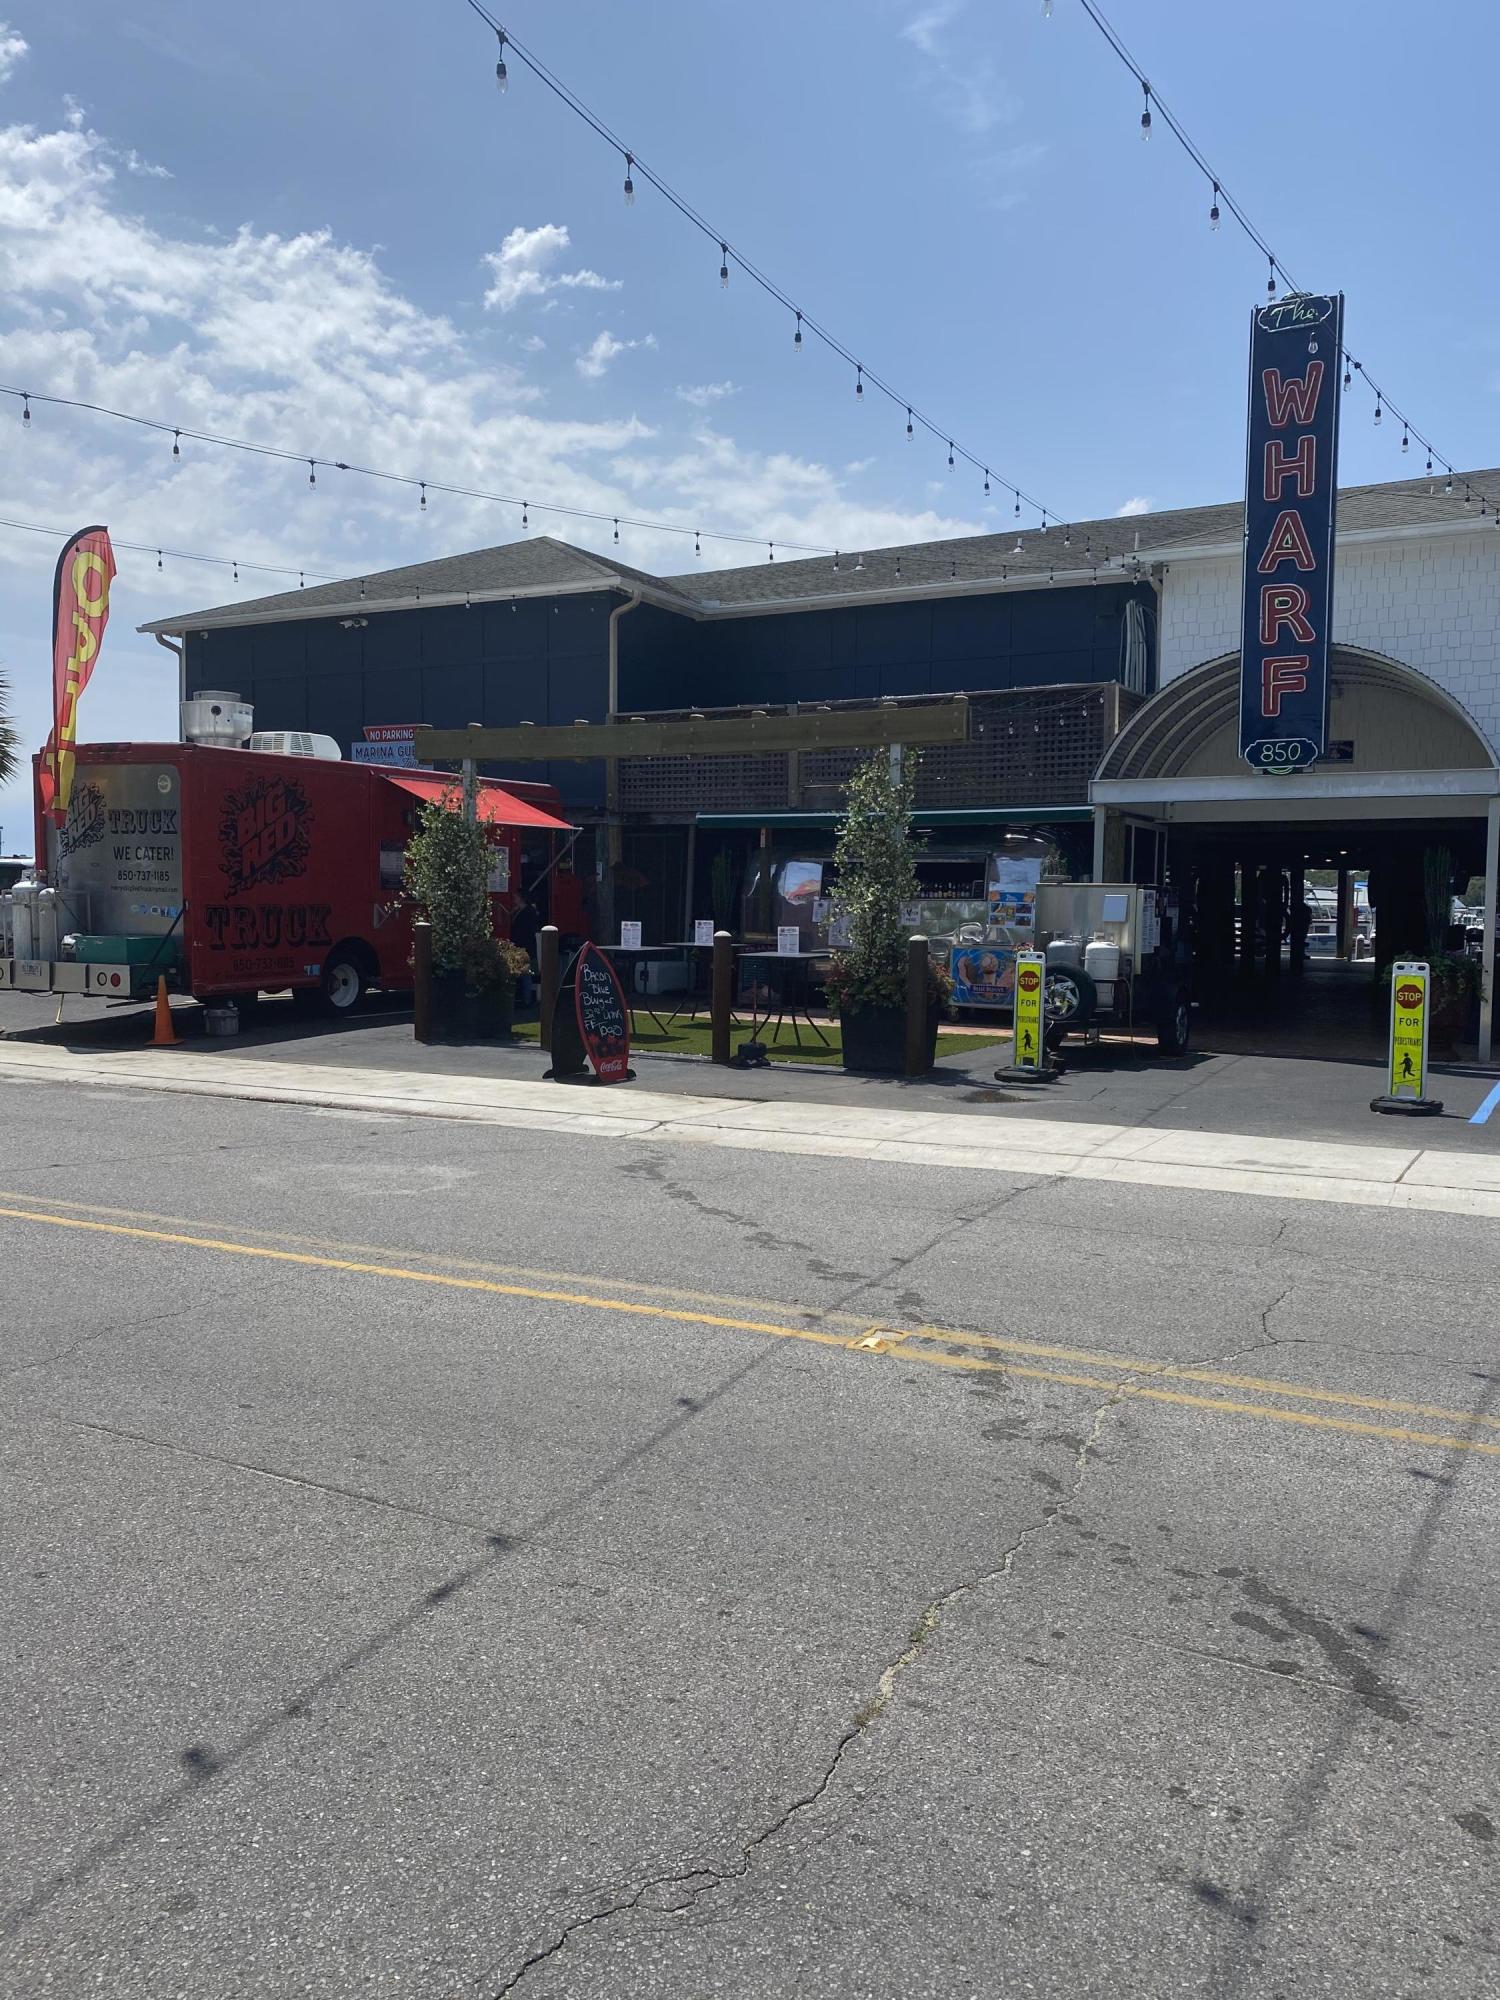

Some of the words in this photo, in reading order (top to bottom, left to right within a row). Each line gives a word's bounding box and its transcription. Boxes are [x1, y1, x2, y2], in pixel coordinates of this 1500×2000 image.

[1270, 299, 1318, 328] The
[1257, 361, 1325, 717] WHARF
[370, 731, 380, 740] NO
[382, 729, 414, 740] PARKING
[355, 747, 393, 759] MARINA
[1260, 742, 1301, 761] 850
[108, 809, 177, 834] TRUCK
[238, 781, 286, 846] BIG
[242, 811, 297, 878] RED
[113, 846, 131, 860] WE
[135, 846, 175, 860] CATER!
[205, 905, 333, 949] TRUCK
[1020, 977, 1039, 985] STOP
[1020, 999, 1037, 1008] FOR
[1398, 992, 1422, 1001] STOP
[1399, 1018, 1419, 1026] FOR
